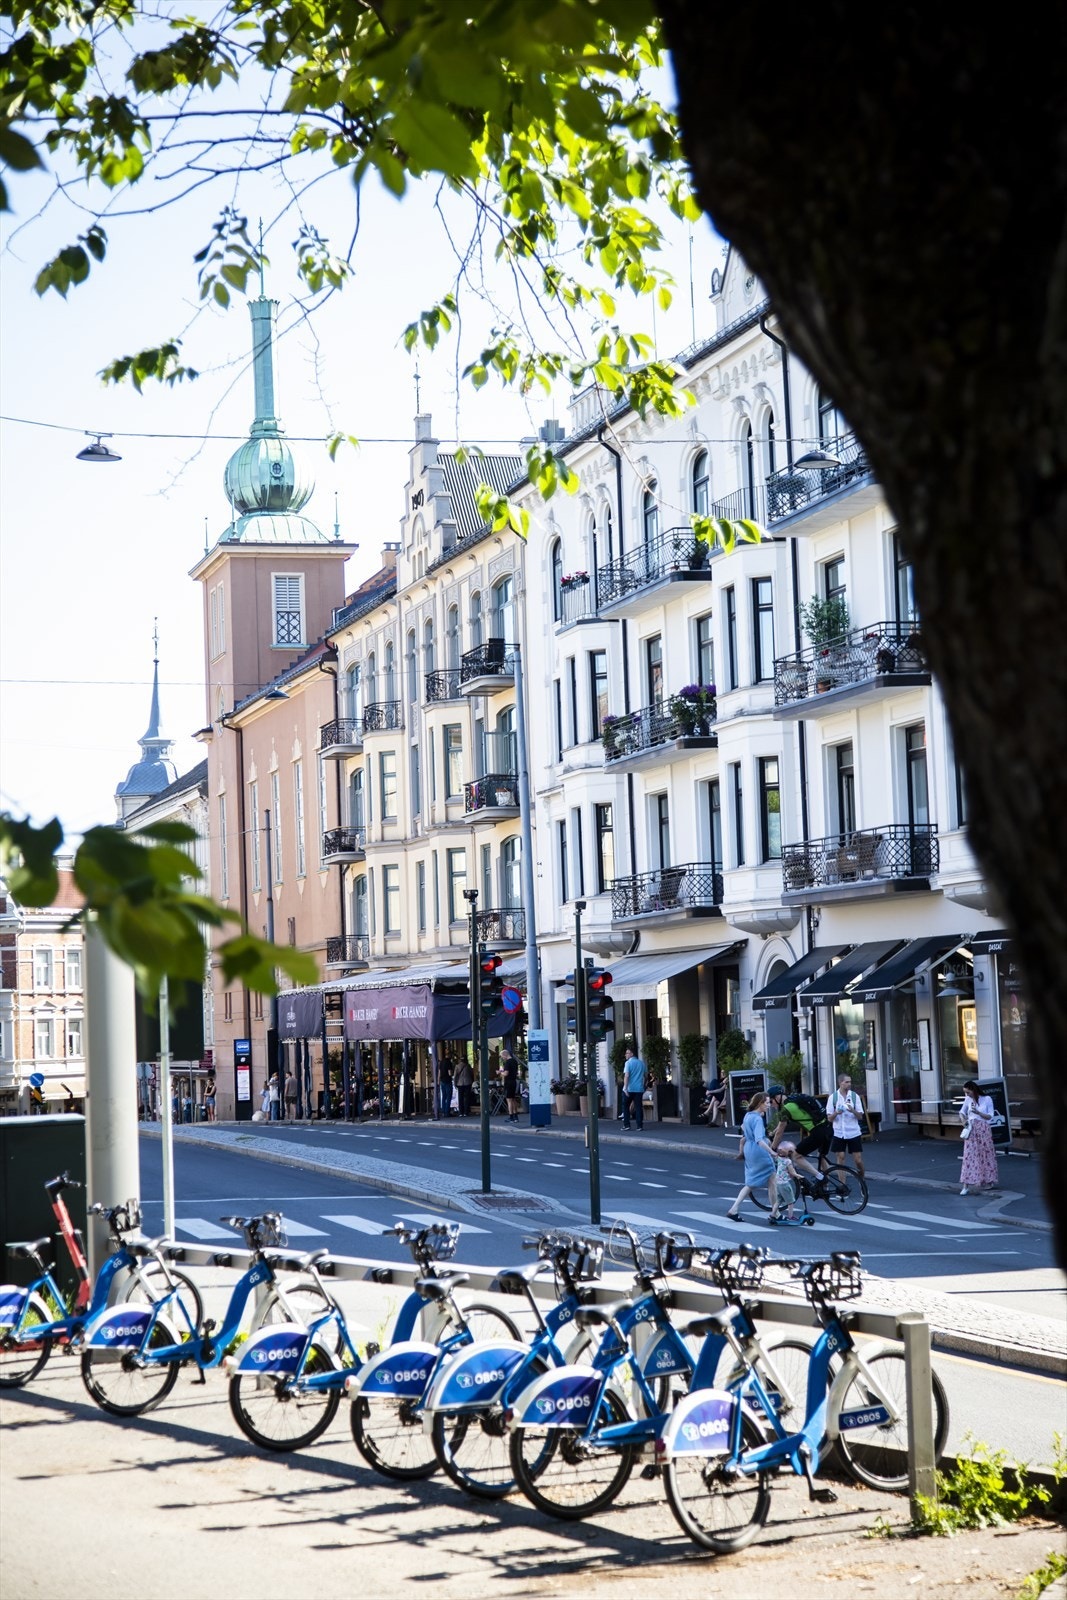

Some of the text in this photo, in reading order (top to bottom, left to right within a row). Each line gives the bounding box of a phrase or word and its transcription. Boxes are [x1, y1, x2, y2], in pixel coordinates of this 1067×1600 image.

[116, 1325, 143, 1337] OBOS
[268, 1347, 298, 1361] OBOS
[656, 1359, 676, 1369] OBOS
[394, 1369, 426, 1382] OBOS
[474, 1370, 505, 1384] OBOS
[556, 1395, 591, 1410] OBOS
[857, 1411, 881, 1424] OBOS
[699, 1418, 729, 1437] OBOS
